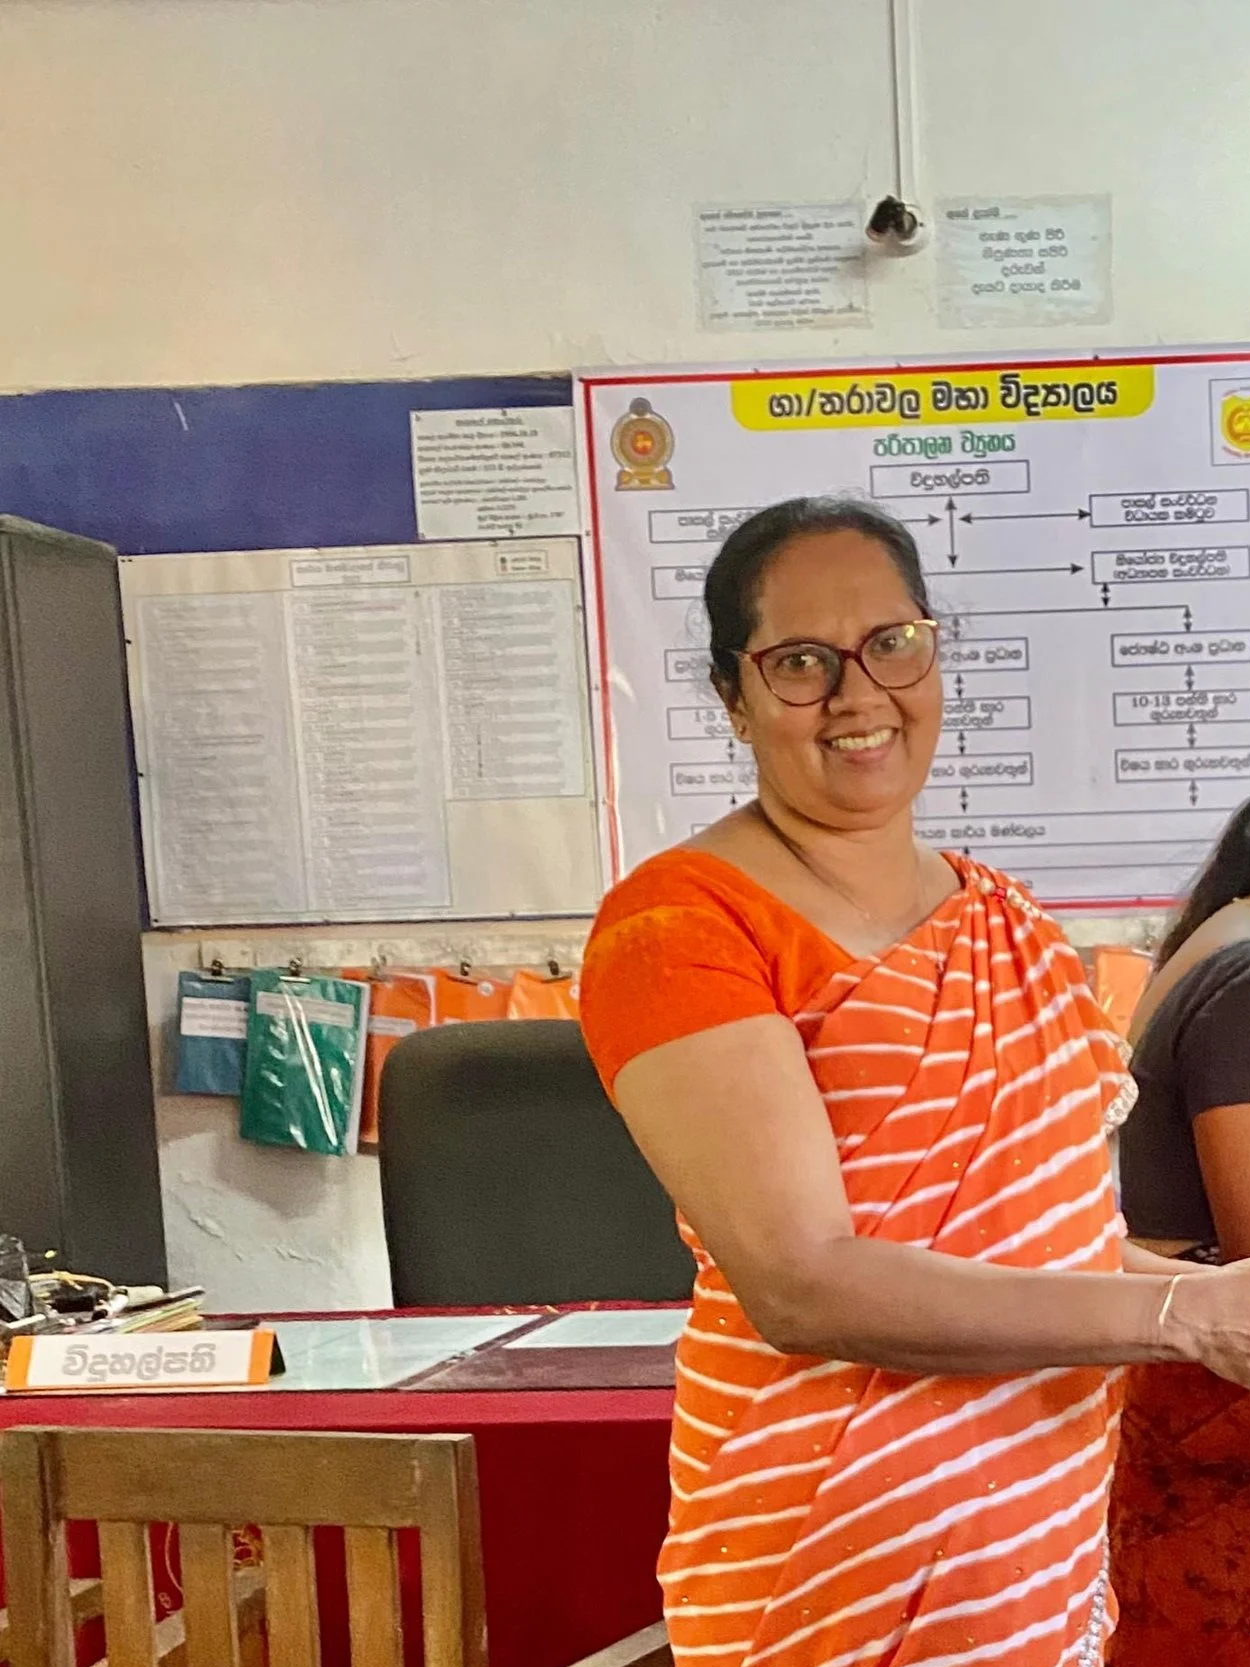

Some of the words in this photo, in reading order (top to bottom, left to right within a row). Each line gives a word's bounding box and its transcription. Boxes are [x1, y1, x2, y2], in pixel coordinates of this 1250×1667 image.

[931, 380, 989, 411] මහා
[999, 373, 1118, 417] විද්‍යාලය
[61, 1342, 217, 1383] විදුහල්පති
